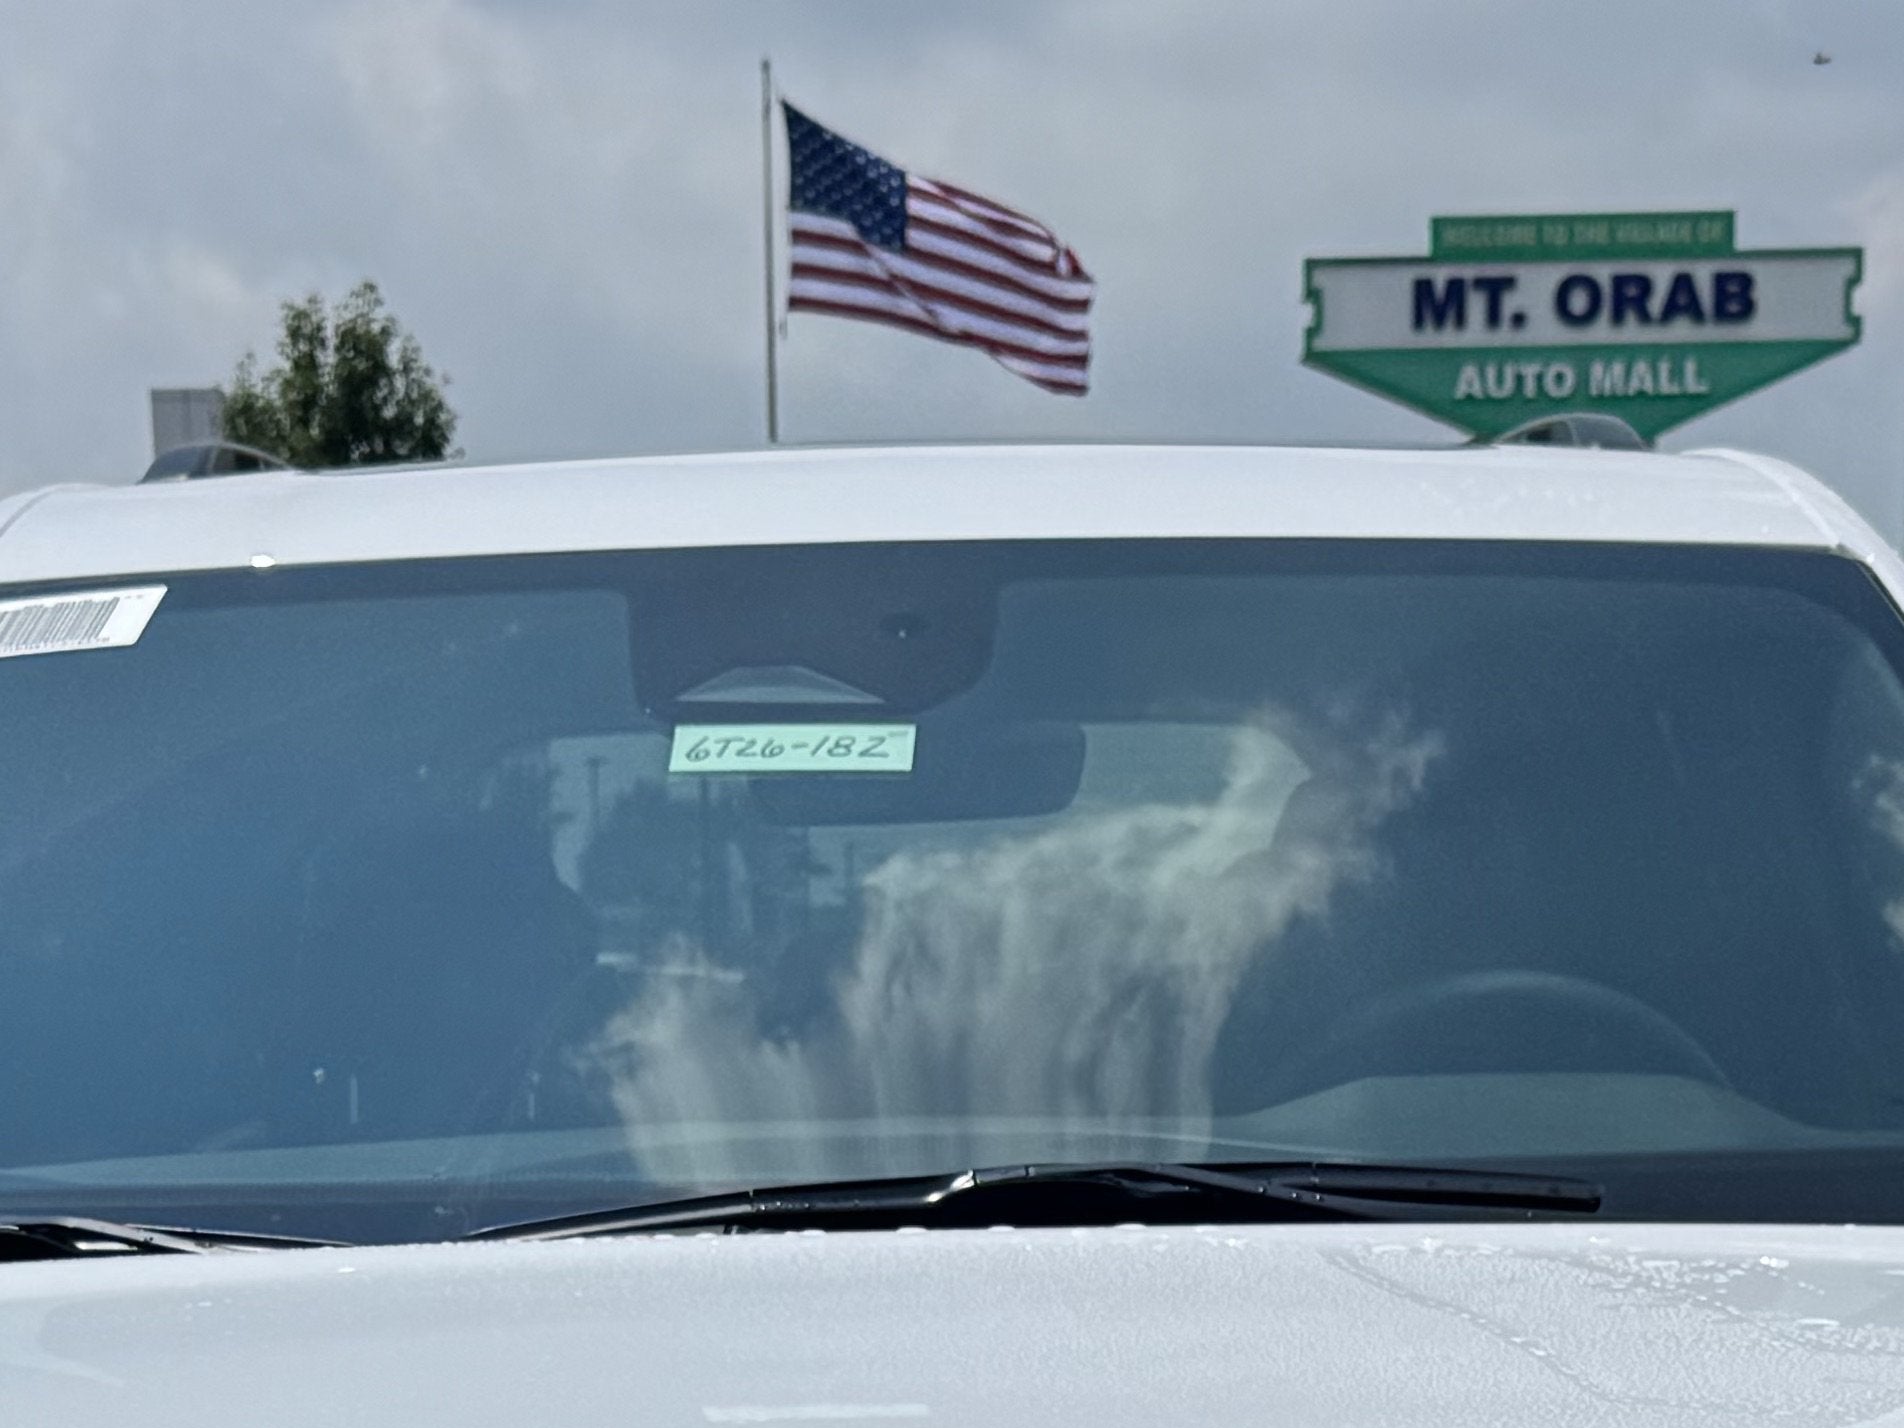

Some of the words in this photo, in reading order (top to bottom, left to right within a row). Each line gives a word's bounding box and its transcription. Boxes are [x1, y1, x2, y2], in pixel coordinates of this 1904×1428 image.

[1411, 275, 1527, 332] MT.
[1554, 270, 1757, 327] ORAB
[1454, 361, 1576, 400] AUTO
[1588, 356, 1710, 396] MALL
